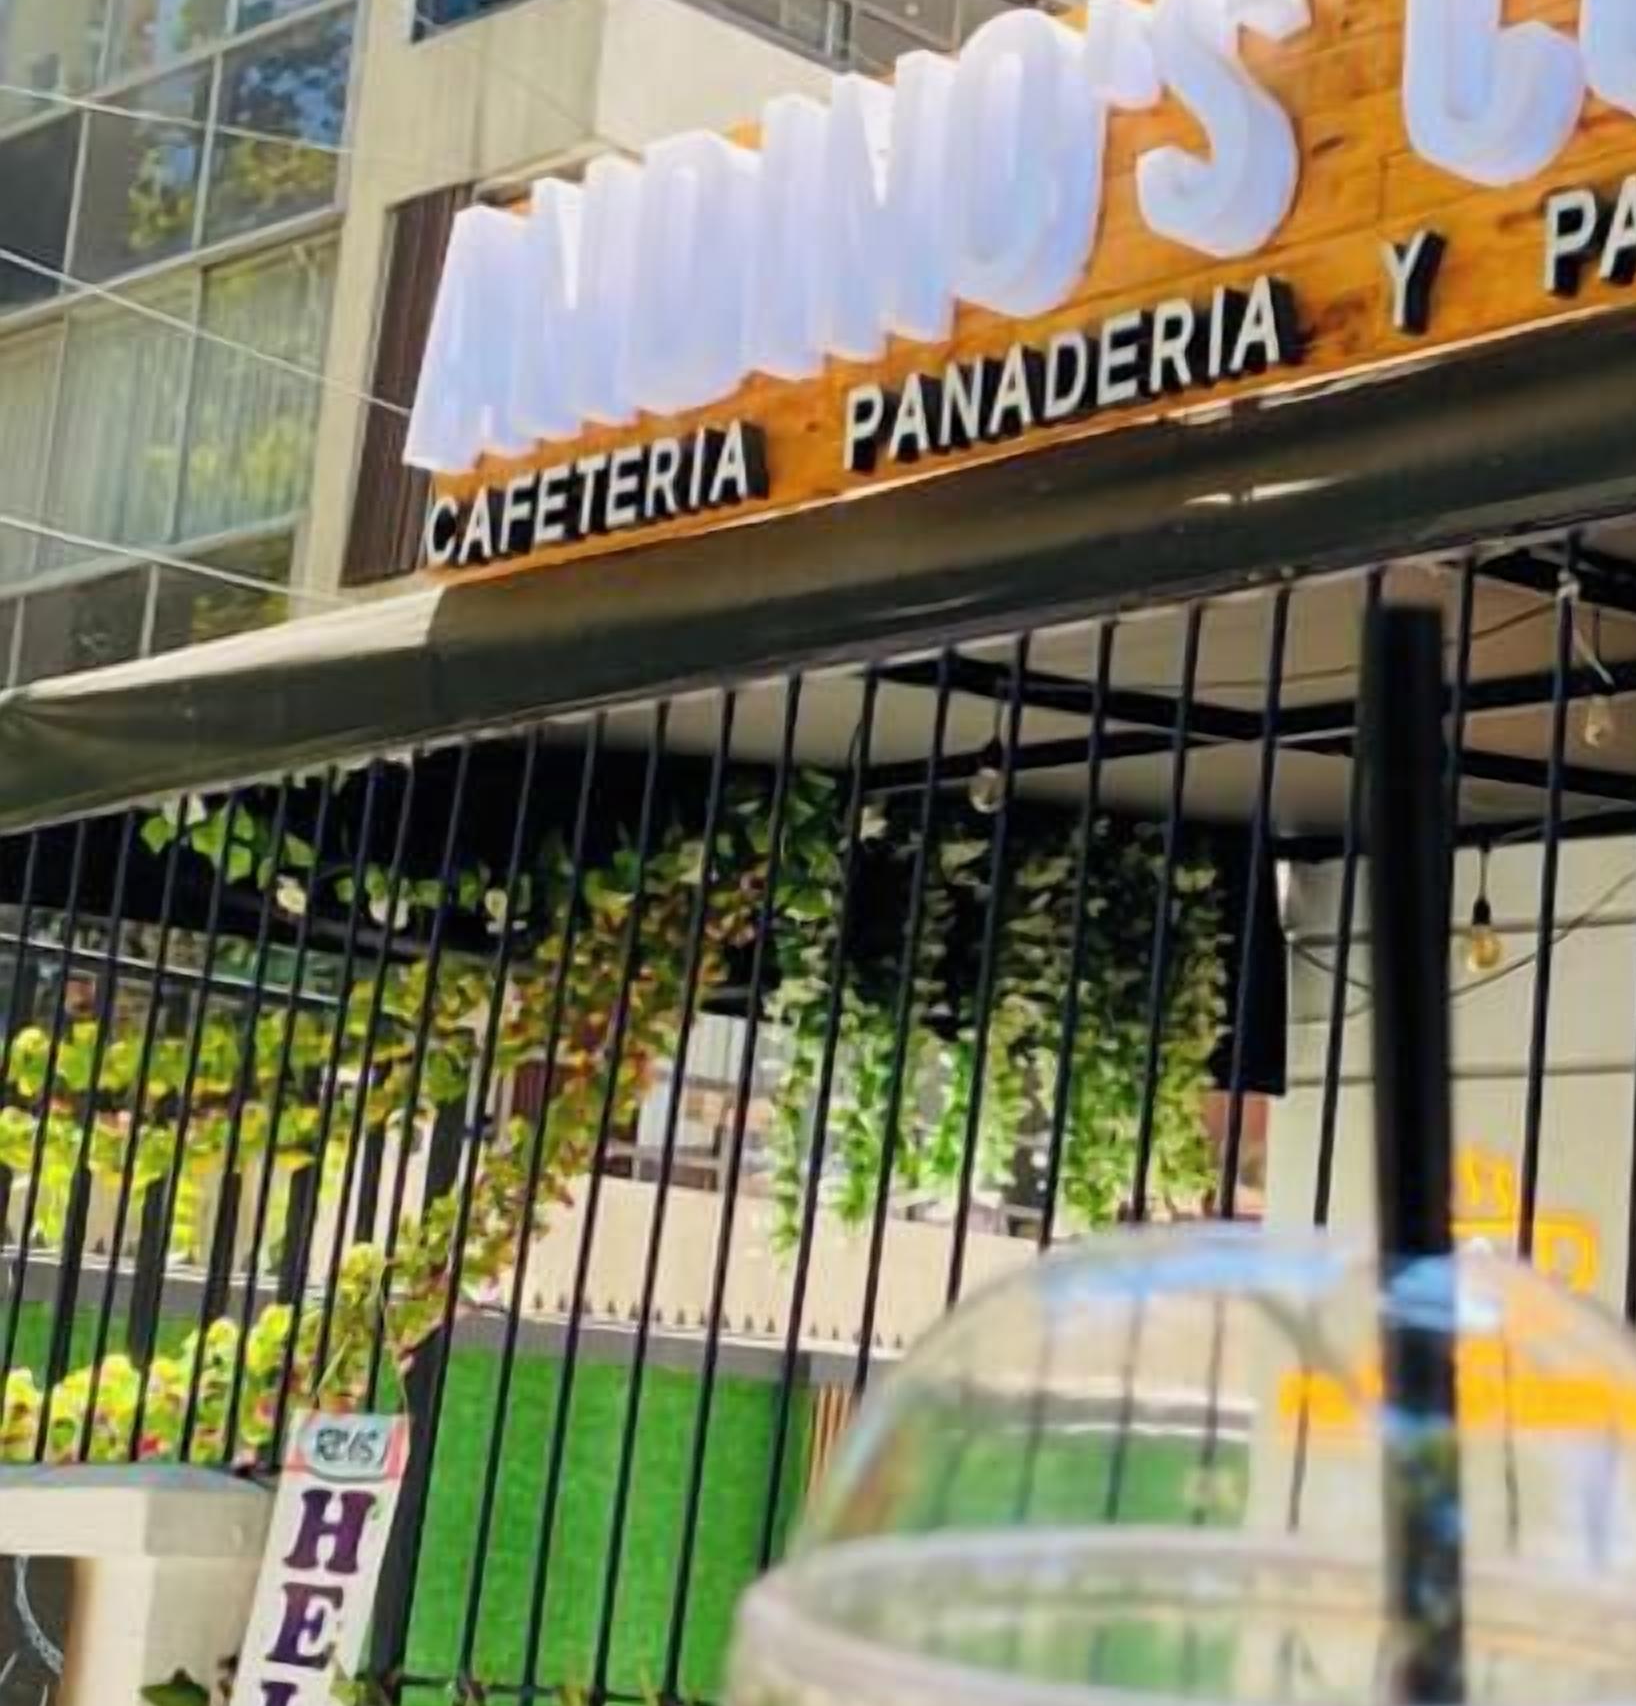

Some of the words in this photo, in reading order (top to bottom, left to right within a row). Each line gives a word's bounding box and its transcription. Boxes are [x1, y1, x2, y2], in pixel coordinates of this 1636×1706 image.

[424, 418, 764, 567] CAFETERIA
[843, 275, 1292, 471] PANADERIA
[1380, 230, 1445, 334] Y
